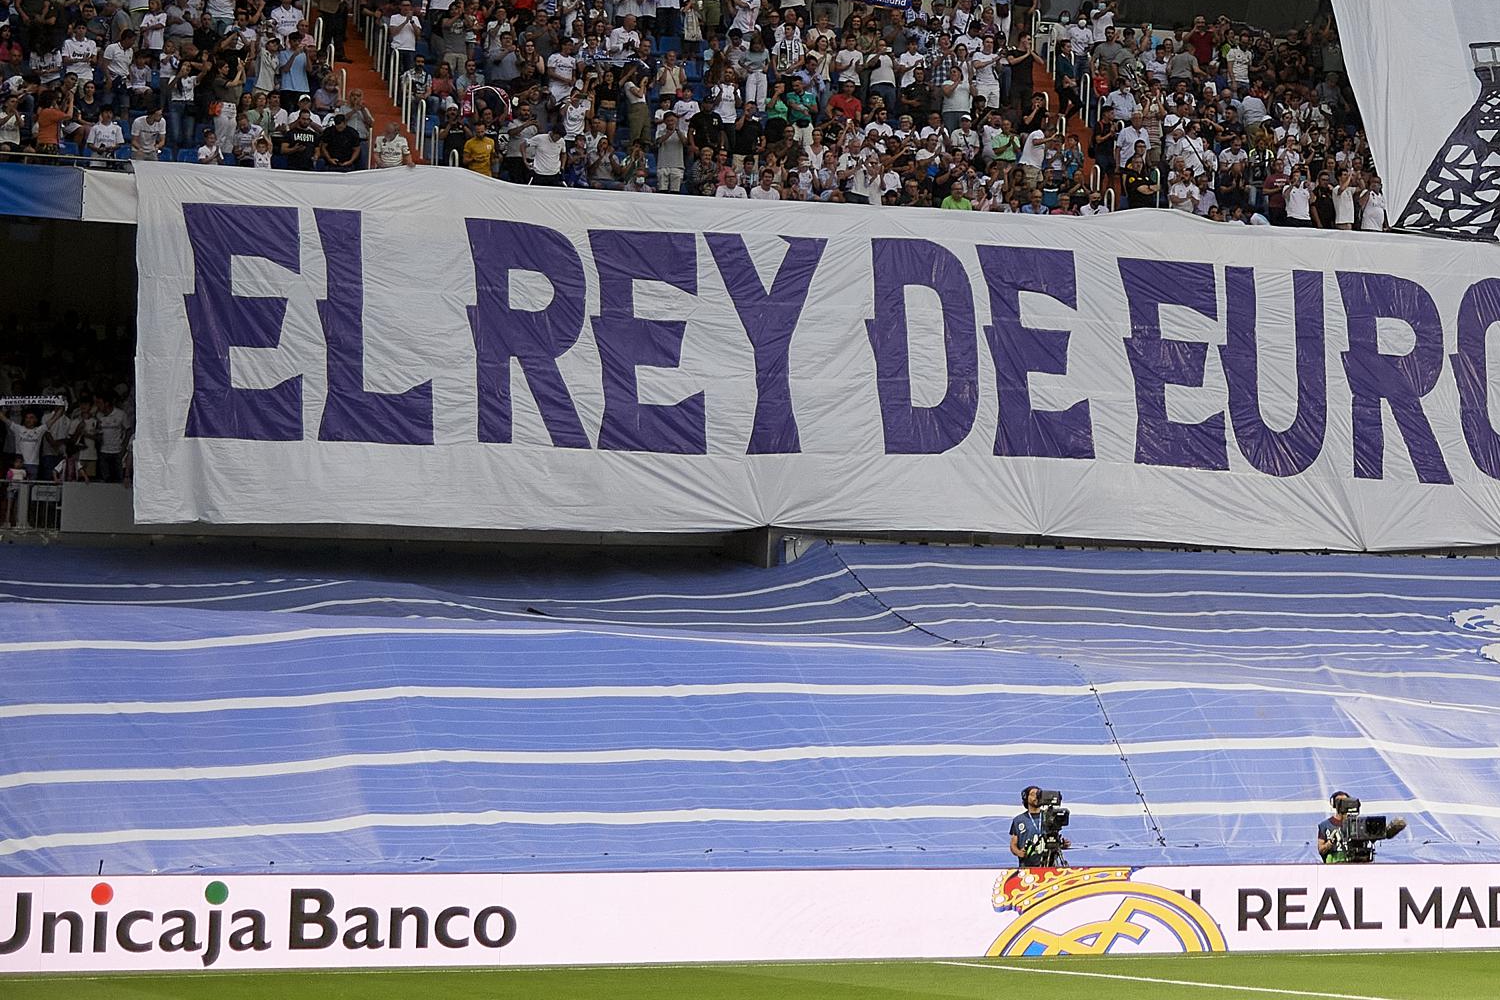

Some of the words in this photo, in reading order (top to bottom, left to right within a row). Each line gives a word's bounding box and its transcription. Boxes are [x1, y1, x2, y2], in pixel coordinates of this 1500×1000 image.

[293, 133, 314, 142] LACOSTE
[185, 204, 433, 444] EL
[465, 218, 827, 454] REY
[866, 240, 1094, 458] DE
[289, 888, 518, 950] Banco
[1237, 886, 1383, 932] REAL
